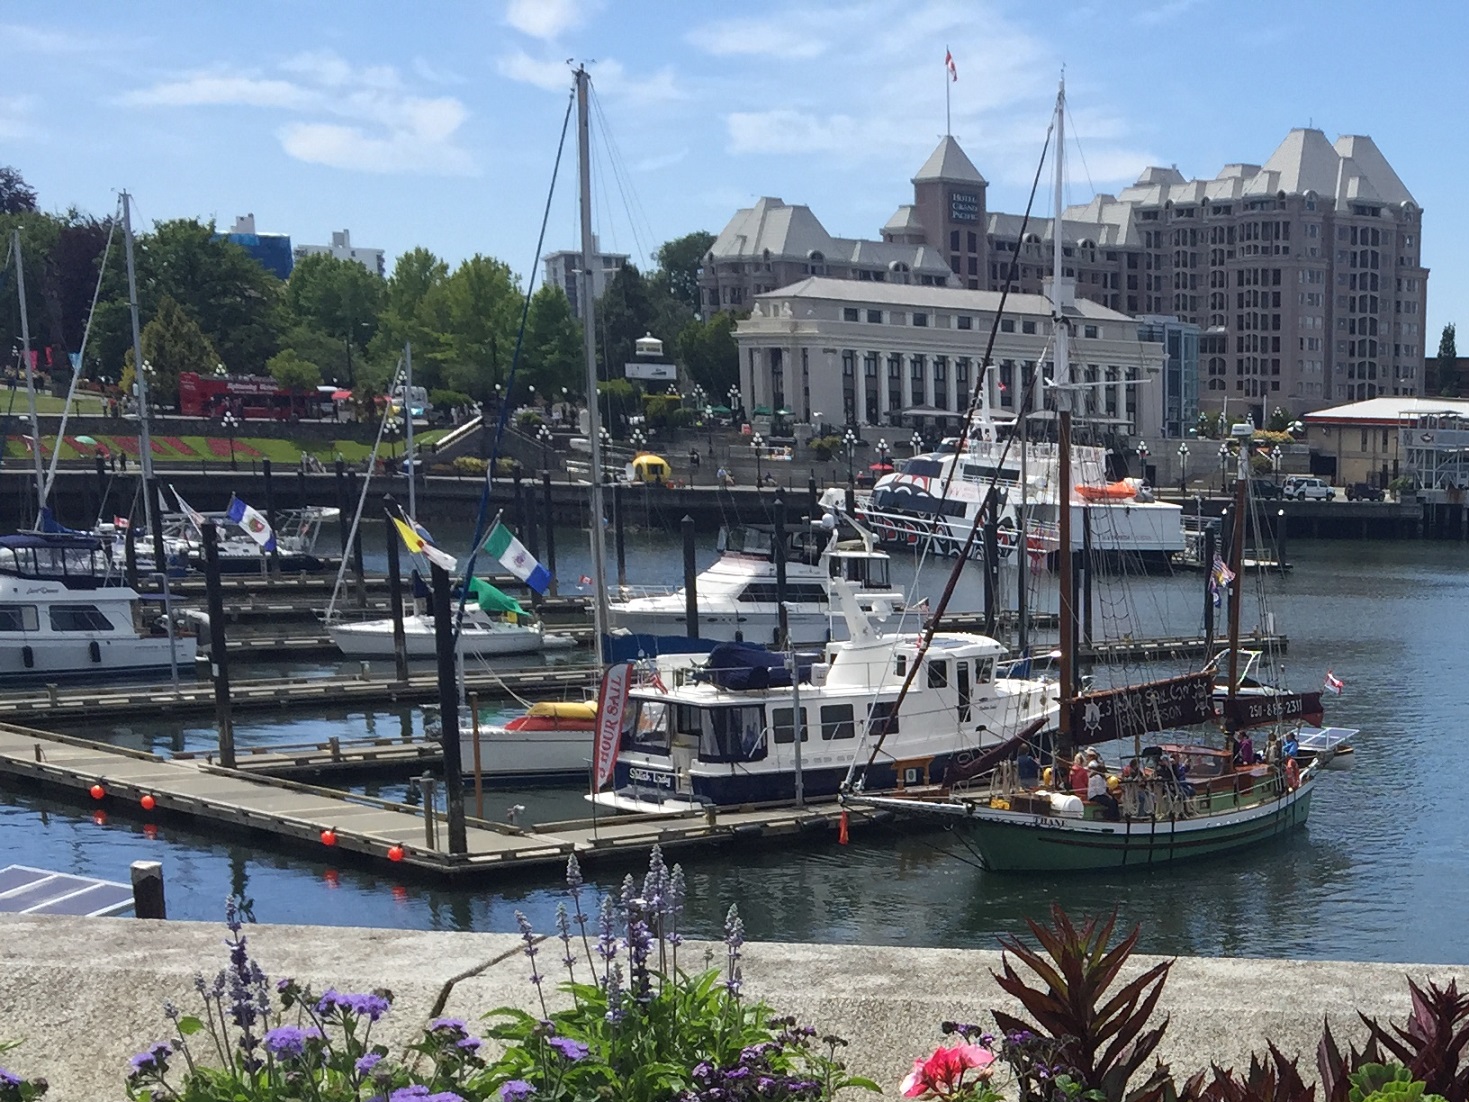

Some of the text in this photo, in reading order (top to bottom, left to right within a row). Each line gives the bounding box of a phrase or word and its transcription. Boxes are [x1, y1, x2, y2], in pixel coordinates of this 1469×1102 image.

[952, 202, 977, 211] GRAND
[606, 675, 622, 716] SAIL
[1105, 699, 1112, 716] 3
[601, 719, 618, 764] HOUR
[1033, 816, 1066, 828] THANE
